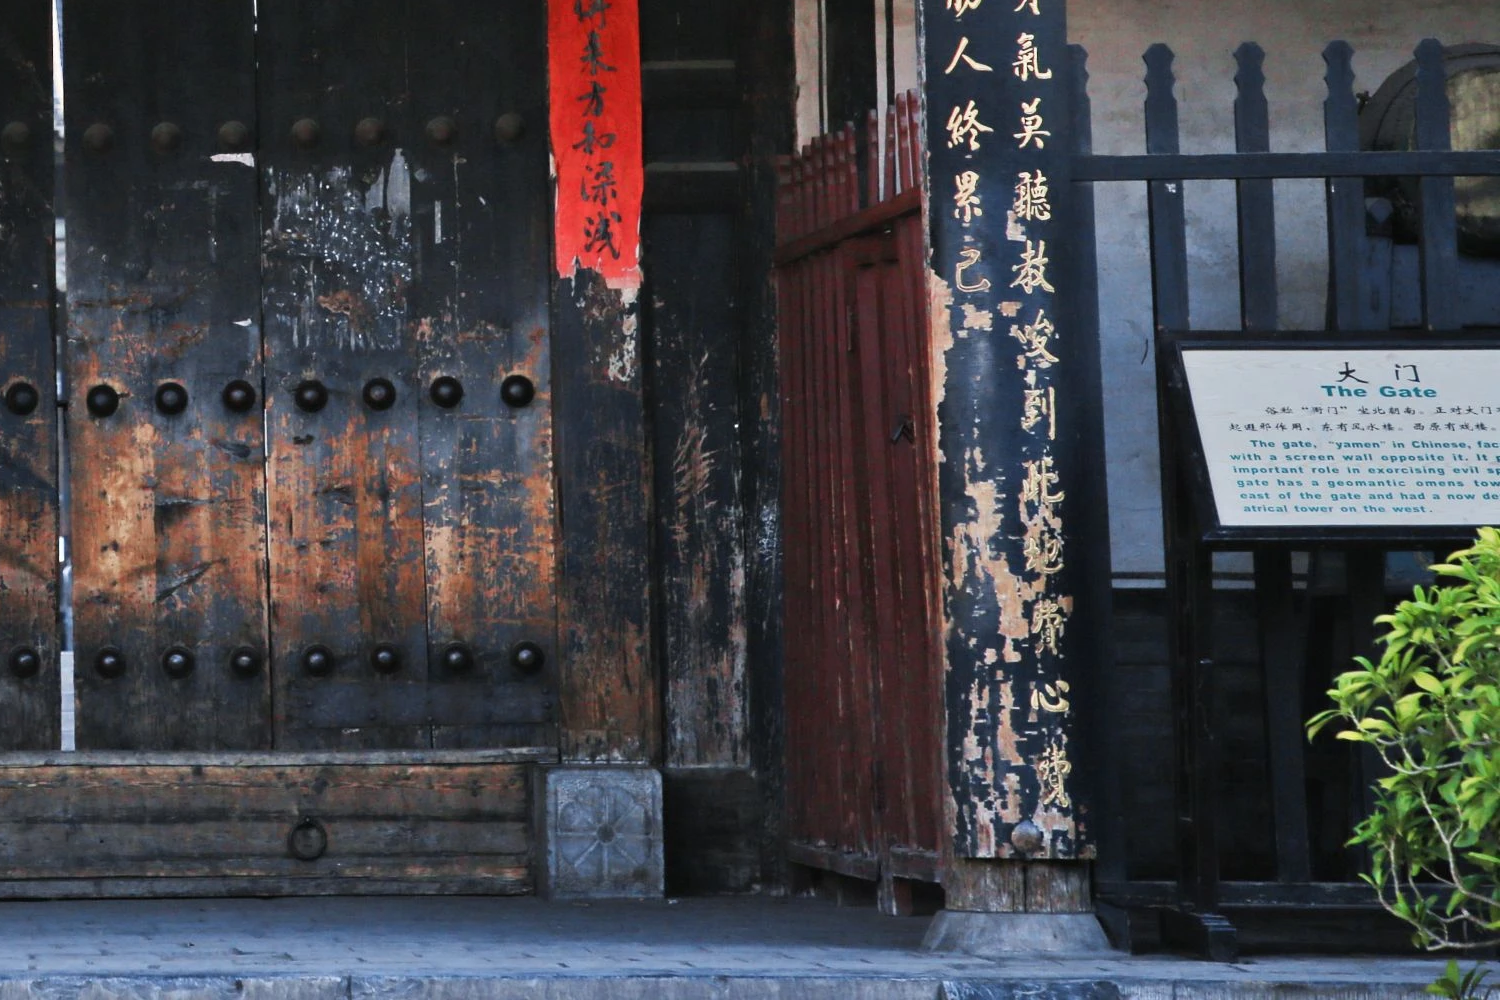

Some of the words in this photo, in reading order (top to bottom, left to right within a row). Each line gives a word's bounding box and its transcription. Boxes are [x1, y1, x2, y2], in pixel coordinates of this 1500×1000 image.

[1335, 361, 1421, 384] 大门
[1320, 385, 1367, 397] The
[1379, 386, 1437, 398] Gate
[1250, 439, 1275, 448] The
[1282, 440, 1317, 449] gate,
[1392, 440, 1405, 449] in
[1411, 440, 1471, 449] Chinese,
[1229, 453, 1262, 461] with
[1342, 453, 1373, 461] wall
[1381, 454, 1445, 463] opposite
[1452, 453, 1469, 461] it.
[1476, 453, 1488, 461] It
[1233, 466, 1304, 475] important
[1311, 466, 1340, 474] role
[1347, 466, 1361, 474] in
[1368, 466, 1445, 475] exorcising
[1452, 466, 1480, 474] evil
[1237, 478, 1269, 488] gate
[1276, 478, 1303, 486] has
[1327, 479, 1406, 488] geomantic
[1240, 491, 1270, 499] east
[1278, 491, 1291, 499] of
[1299, 491, 1322, 499] the
[1330, 491, 1361, 501] gate
[1368, 491, 1393, 500] and
[1400, 491, 1425, 500] had
[1243, 504, 1288, 512] atrical
[1294, 505, 1334, 513] tower
[1363, 505, 1386, 513] the
